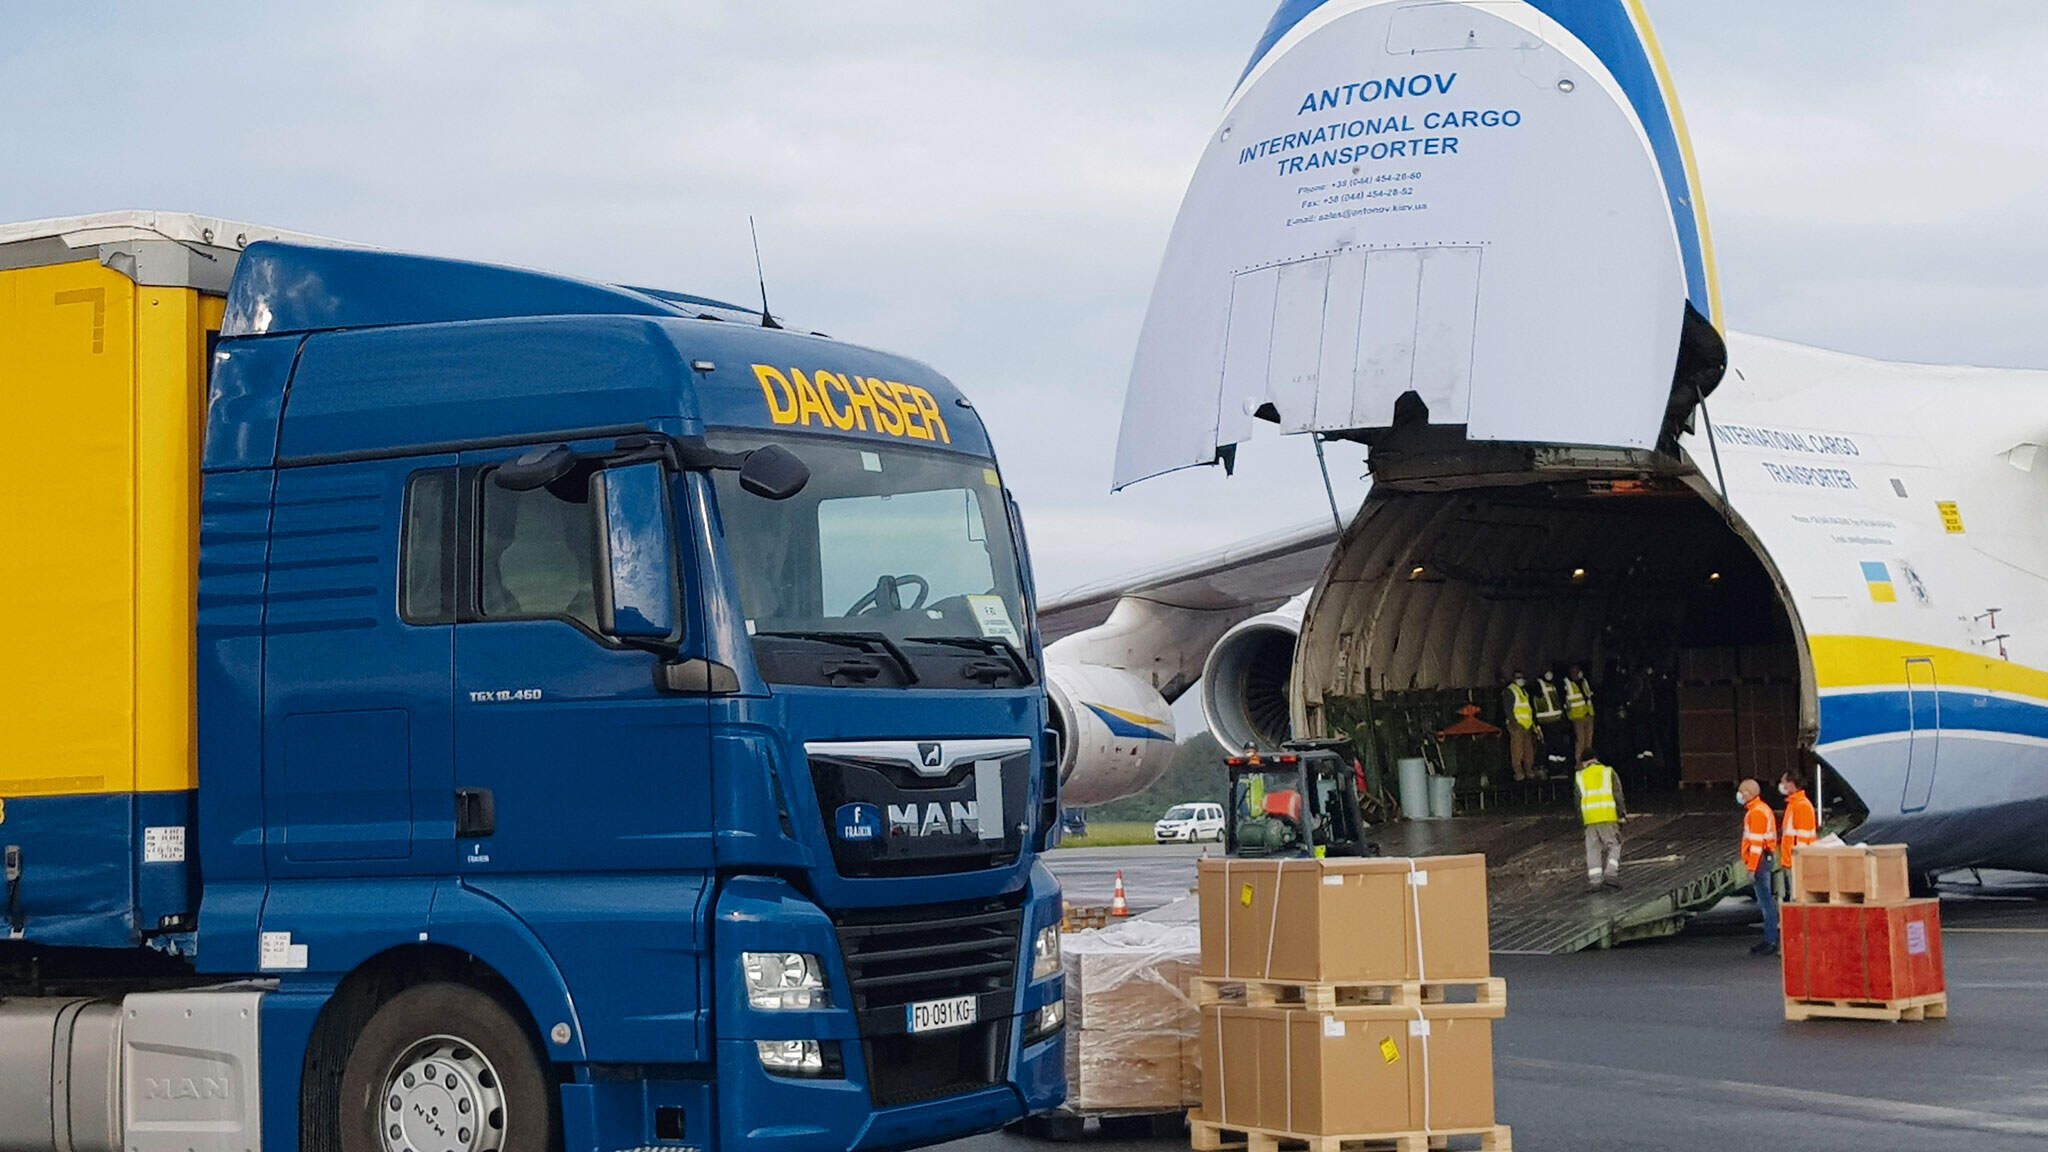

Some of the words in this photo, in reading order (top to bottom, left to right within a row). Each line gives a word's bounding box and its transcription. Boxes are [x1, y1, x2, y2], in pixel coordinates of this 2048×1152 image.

[1298, 73, 1457, 115] ANTONOV
[1239, 115, 1415, 165] INTERNATIONAL
[1424, 110, 1521, 129] CARGO
[1278, 137, 1459, 177] TRANSPORTER
[752, 364, 950, 444] DACHSER
[1712, 424, 1814, 453] INTERNATIONAL
[1809, 434, 1860, 456] CARGO
[1762, 462, 1859, 489] TRANSPORTER
[469, 690, 495, 702] TGX
[888, 800, 978, 838] MAN
[144, 1078, 229, 1099] MAN
